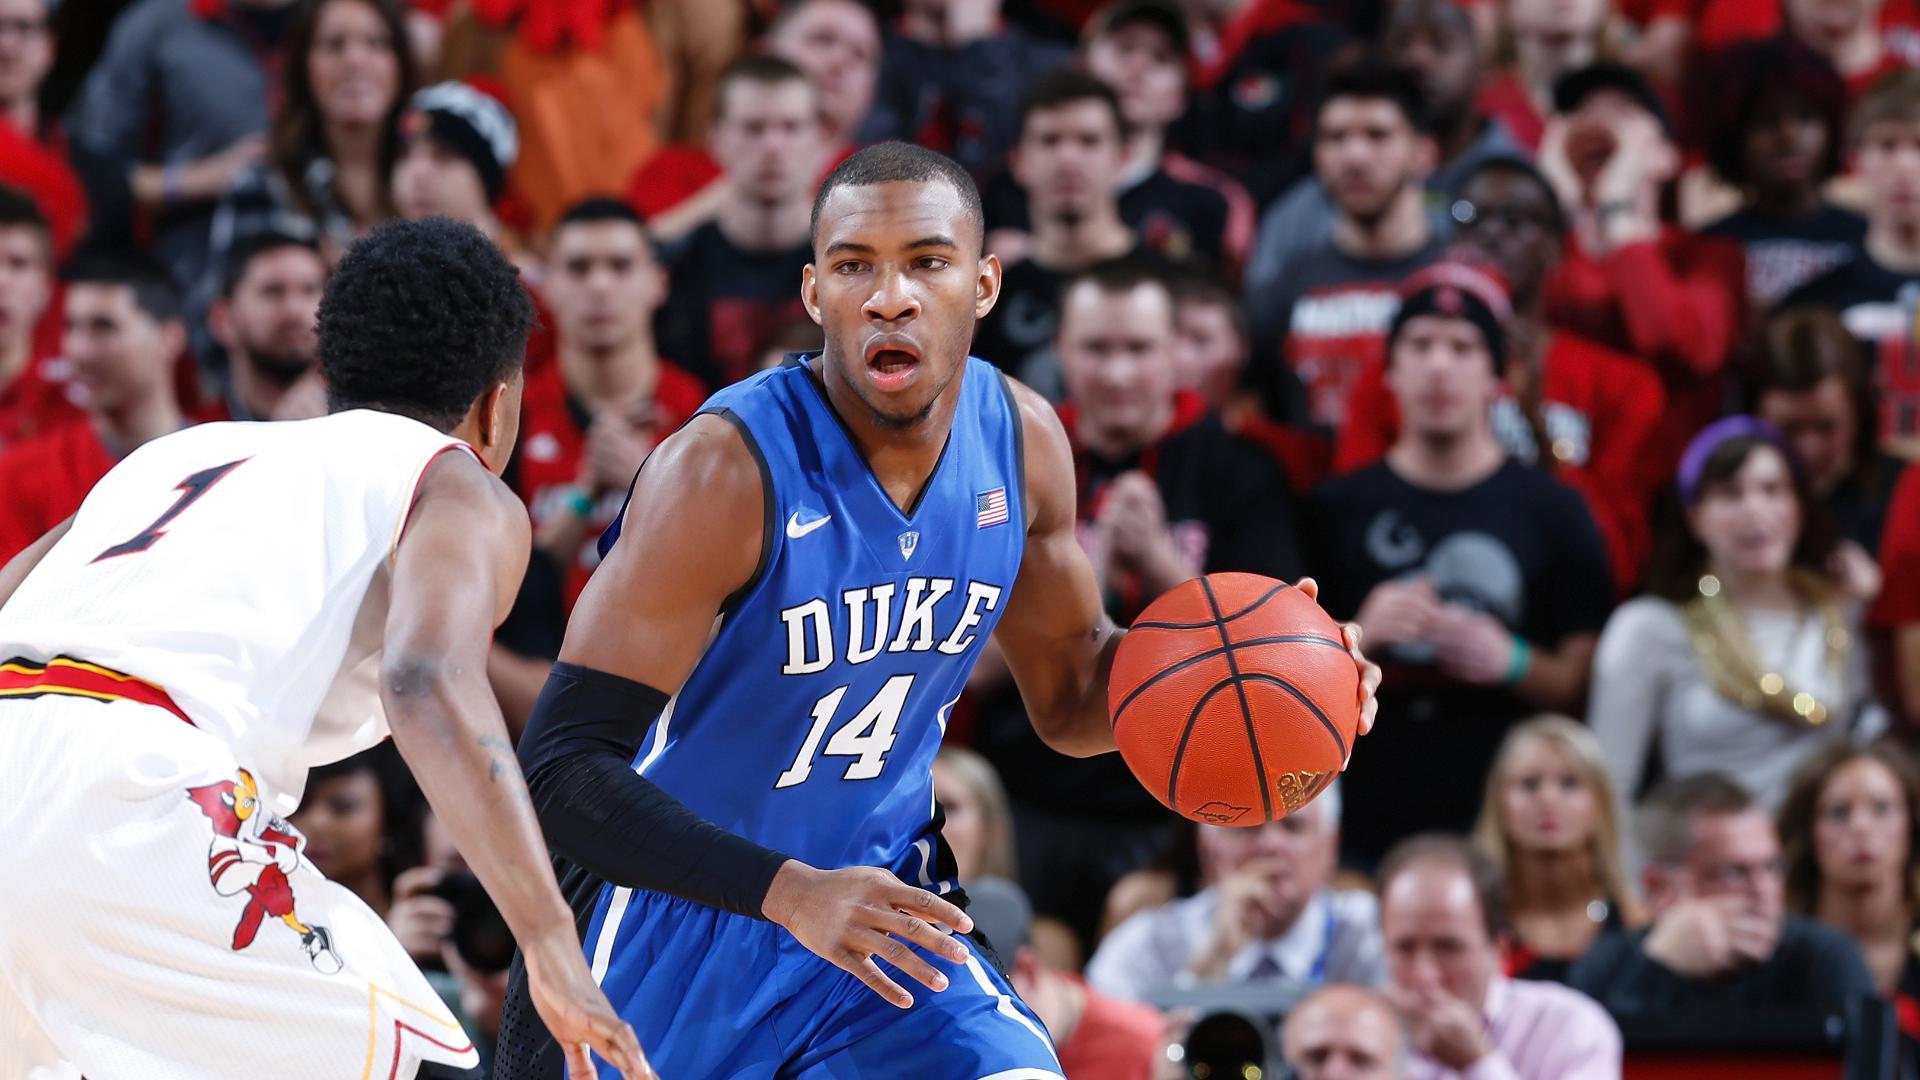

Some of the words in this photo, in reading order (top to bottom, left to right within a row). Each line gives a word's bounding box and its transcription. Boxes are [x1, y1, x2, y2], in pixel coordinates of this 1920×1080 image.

[87, 456, 252, 565] 1
[781, 576, 1001, 674] DUKE
[773, 673, 917, 788] 14
